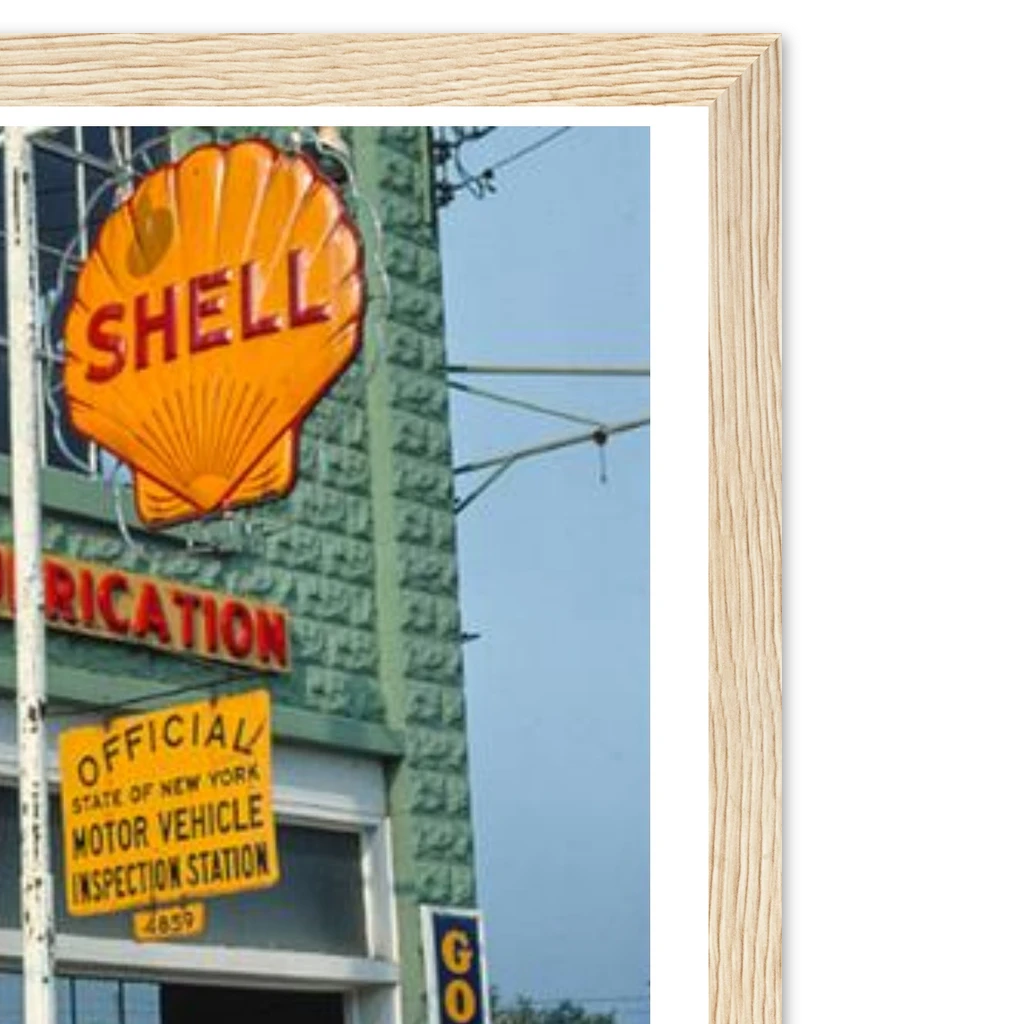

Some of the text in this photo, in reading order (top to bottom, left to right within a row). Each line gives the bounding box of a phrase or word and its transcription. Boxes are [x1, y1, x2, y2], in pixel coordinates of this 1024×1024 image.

[85, 249, 330, 383] SHELL
[77, 712, 256, 787] OFFICIAL
[72, 763, 261, 814] STATE OF NEW YORK
[72, 793, 264, 860] MOTOR VEHICLE
[72, 841, 270, 906] INSPECTION STATION
